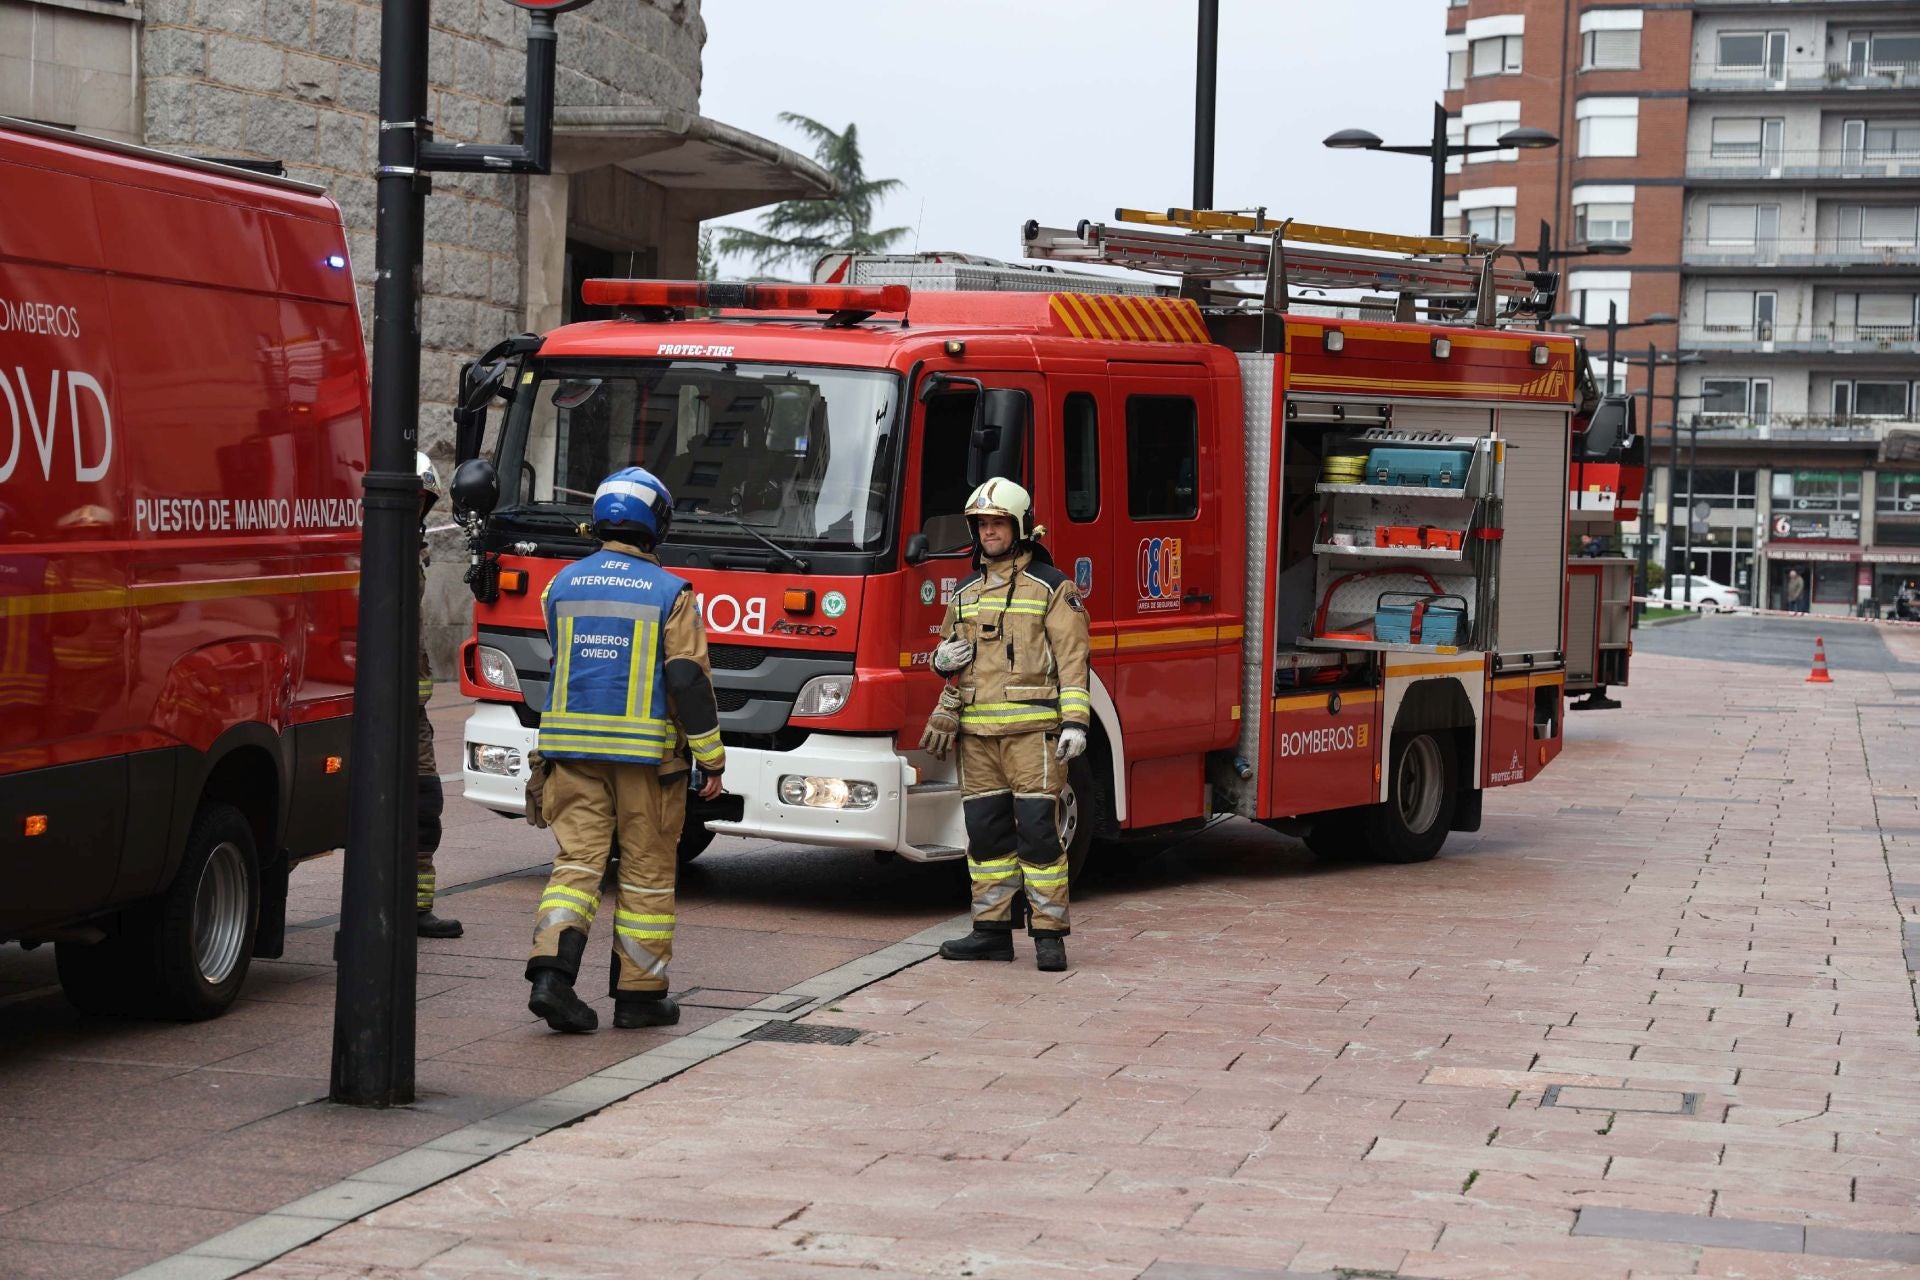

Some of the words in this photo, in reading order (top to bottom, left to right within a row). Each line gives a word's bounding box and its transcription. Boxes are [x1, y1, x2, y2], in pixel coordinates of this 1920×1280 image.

[657, 344, 735, 357] PROTEC-FIRE
[136, 499, 204, 531] PUESTO
[209, 499, 230, 530] DE
[235, 499, 290, 530] MANDO
[601, 560, 631, 571] JEFE
[1138, 538, 1172, 597] 080
[570, 575, 653, 591] INTERVENCIÓN
[574, 634, 629, 647] BOMBEROS
[581, 648, 618, 659] OVIEDO
[1281, 725, 1354, 757] BOMBEROS
